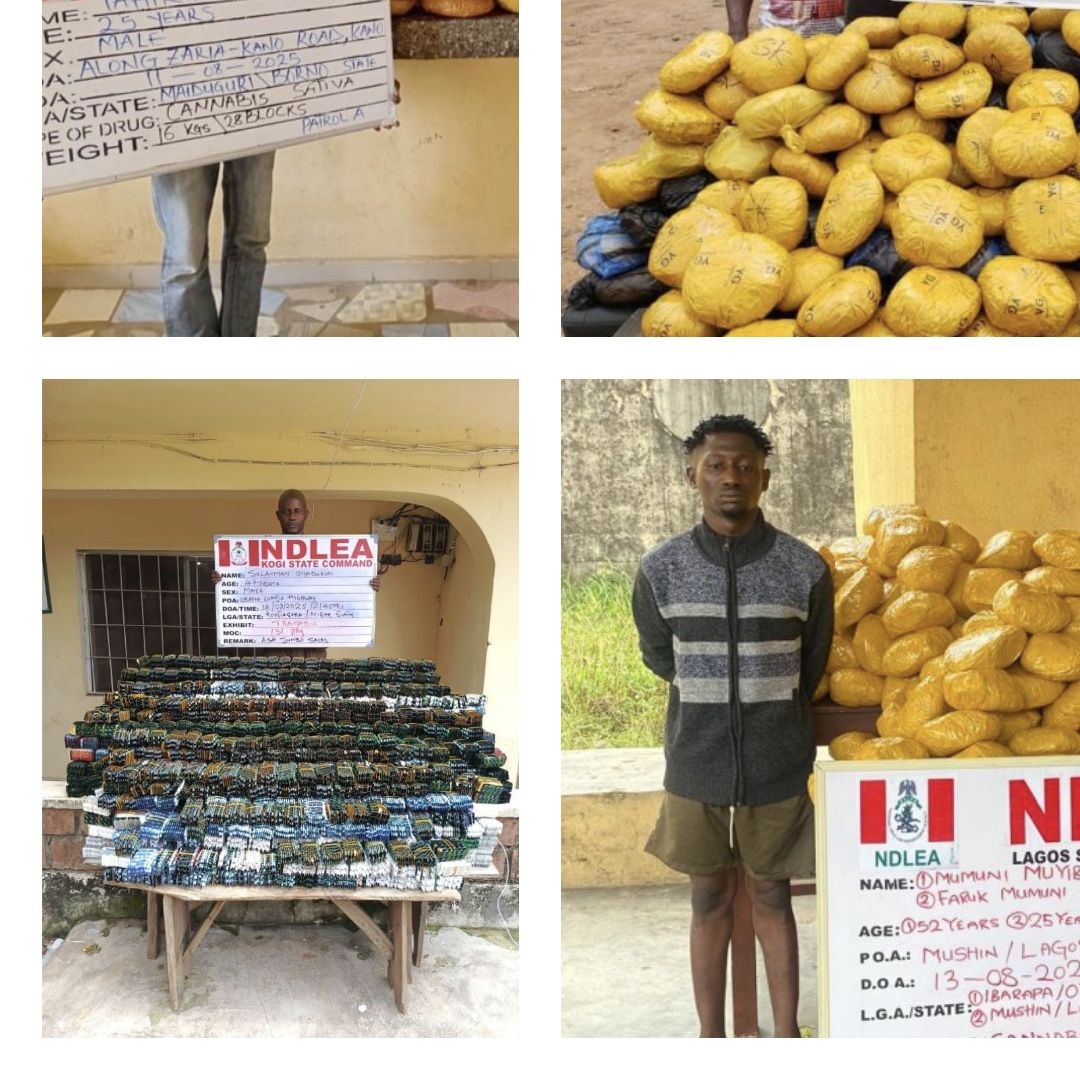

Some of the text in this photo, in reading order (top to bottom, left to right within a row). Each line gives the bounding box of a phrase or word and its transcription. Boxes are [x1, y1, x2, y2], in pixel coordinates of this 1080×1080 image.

[98, 7, 215, 35] 25 YEARS
[98, 32, 166, 54] MALE
[166, 78, 355, 121] CANNABIS SATIVA
[66, 124, 95, 141] OF
[261, 538, 374, 560] NDLEA
[261, 559, 373, 568] KOGI STATE COMMAND
[874, 848, 941, 868] NDLEA
[1012, 849, 1072, 866] LAGOS
[860, 877, 914, 892] NAME:
[1000, 886, 1067, 902] MUMUNI
[859, 924, 901, 939] AGE:
[922, 944, 998, 964] MUSHIN
